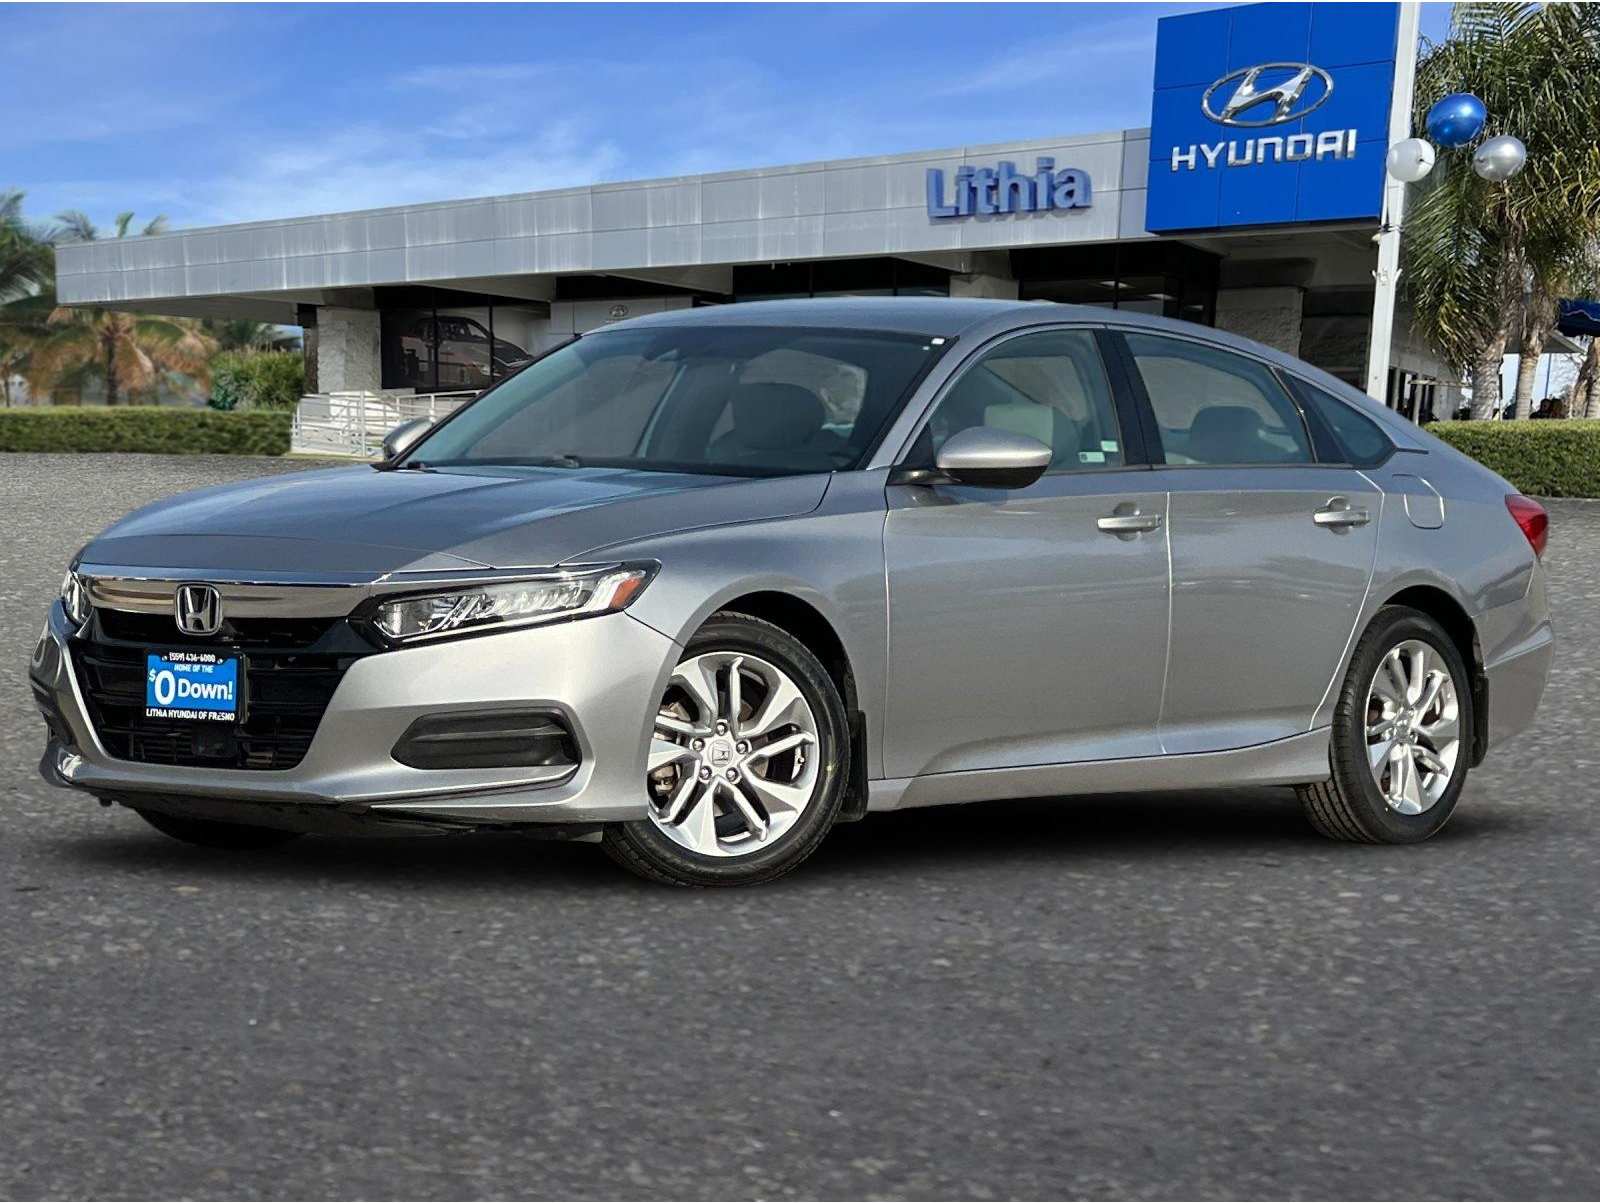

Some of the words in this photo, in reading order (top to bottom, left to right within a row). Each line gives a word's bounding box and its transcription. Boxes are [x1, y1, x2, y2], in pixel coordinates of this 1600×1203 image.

[1171, 128, 1357, 172] HYUNDAI
[926, 156, 1093, 217] Lithia
[193, 664, 200, 672] OF
[202, 665, 214, 673] THE
[178, 678, 233, 700] Down!
[146, 708, 167, 717] LITHIA
[168, 710, 197, 719] HYUNDAI
[198, 711, 207, 720] OF
[208, 712, 235, 721] FRESNO
